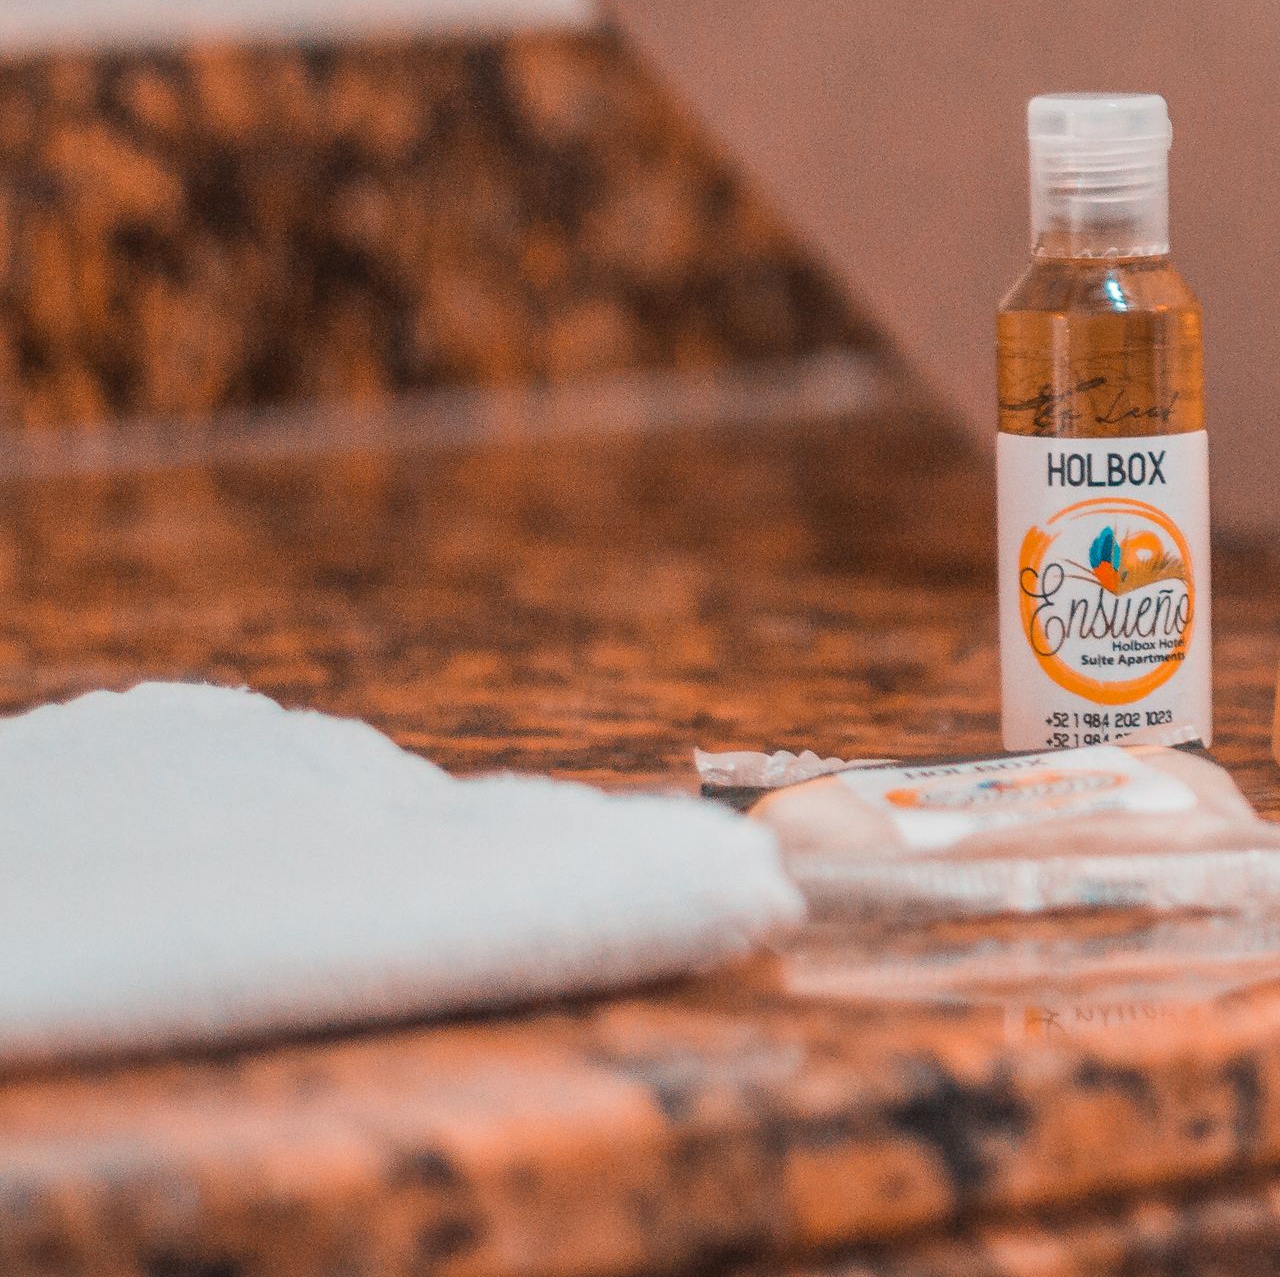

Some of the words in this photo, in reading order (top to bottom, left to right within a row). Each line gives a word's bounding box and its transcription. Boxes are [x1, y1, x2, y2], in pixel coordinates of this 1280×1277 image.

[1048, 450, 1167, 487] HOLBOX
[1019, 562, 1192, 657] Ensueño
[1112, 639, 1156, 652] Holbox
[1081, 654, 1114, 666] Suite
[1045, 711, 1069, 728] +52
[1083, 712, 1109, 728] 984
[1114, 712, 1140, 728] 202
[1146, 709, 1172, 725] 1023
[1046, 732, 1069, 748] +52
